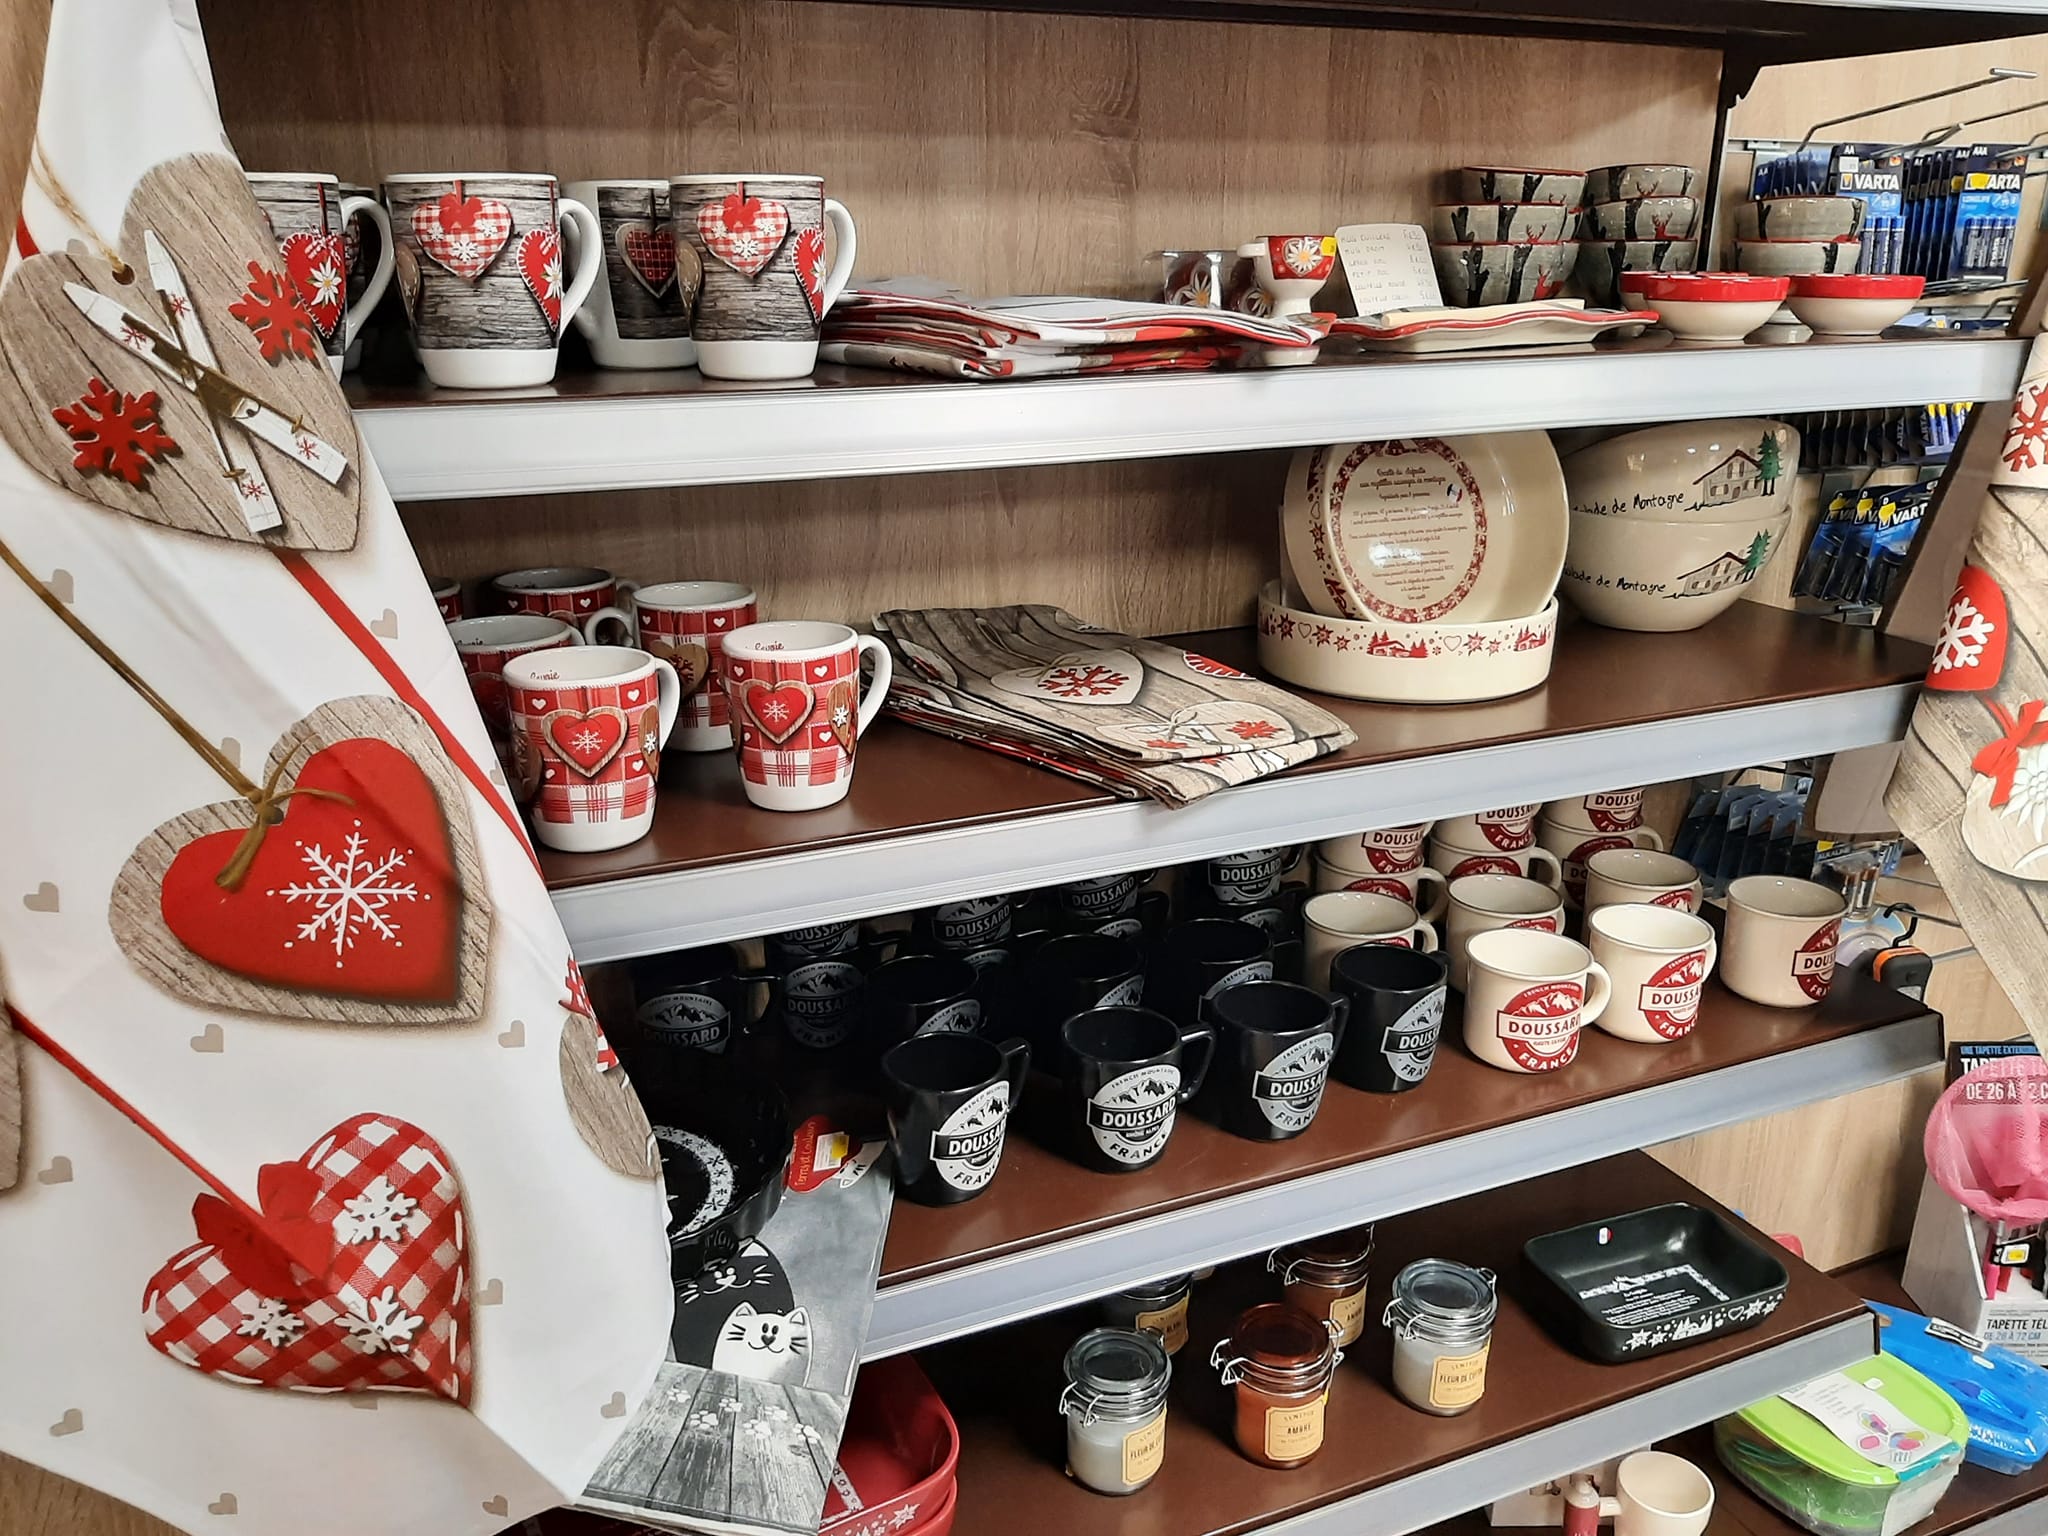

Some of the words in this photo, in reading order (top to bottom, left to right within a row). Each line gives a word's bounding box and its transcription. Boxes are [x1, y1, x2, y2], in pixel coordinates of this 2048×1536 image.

[1854, 173, 1900, 191] VARTA
[1983, 173, 2021, 191] ARTA
[1611, 497, 1626, 514] de
[1633, 493, 1684, 510] Montagne
[1892, 502, 1928, 525] VART
[1564, 567, 1591, 583] alade
[1596, 574, 1610, 588] de
[1616, 577, 1666, 596] Montagne
[1220, 858, 1281, 882] DOUSSARD
[1071, 875, 1135, 907] DOUSSARD
[945, 906, 1011, 938] DOUSSARD
[1651, 985, 1699, 1005] DOUSSA
[787, 998, 848, 1015] DOUSSA
[1508, 1012, 1581, 1036] DOUSSARD
[1659, 1013, 1698, 1037] FRANC
[1398, 1027, 1438, 1050] DOUSS
[1518, 1046, 1573, 1071] FRANCE
[1401, 1063, 1428, 1077] FRA
[1269, 1072, 1323, 1097] DOUSSA
[1966, 1082, 1984, 1100] DE
[1987, 1082, 2004, 1100] 26
[2007, 1079, 2017, 1100] À
[1101, 1096, 1176, 1128] DOUSSARD
[1275, 1109, 1315, 1126] FRAN
[948, 1124, 1001, 1156] DOUSSA
[953, 1166, 996, 1185] FRAN
[1986, 1319, 2030, 1330] TAPETTE
[2031, 1317, 2048, 1330] TÉL
[1439, 1374, 1460, 1384] FLEUR
[1130, 1446, 1148, 1460] FLEUR
